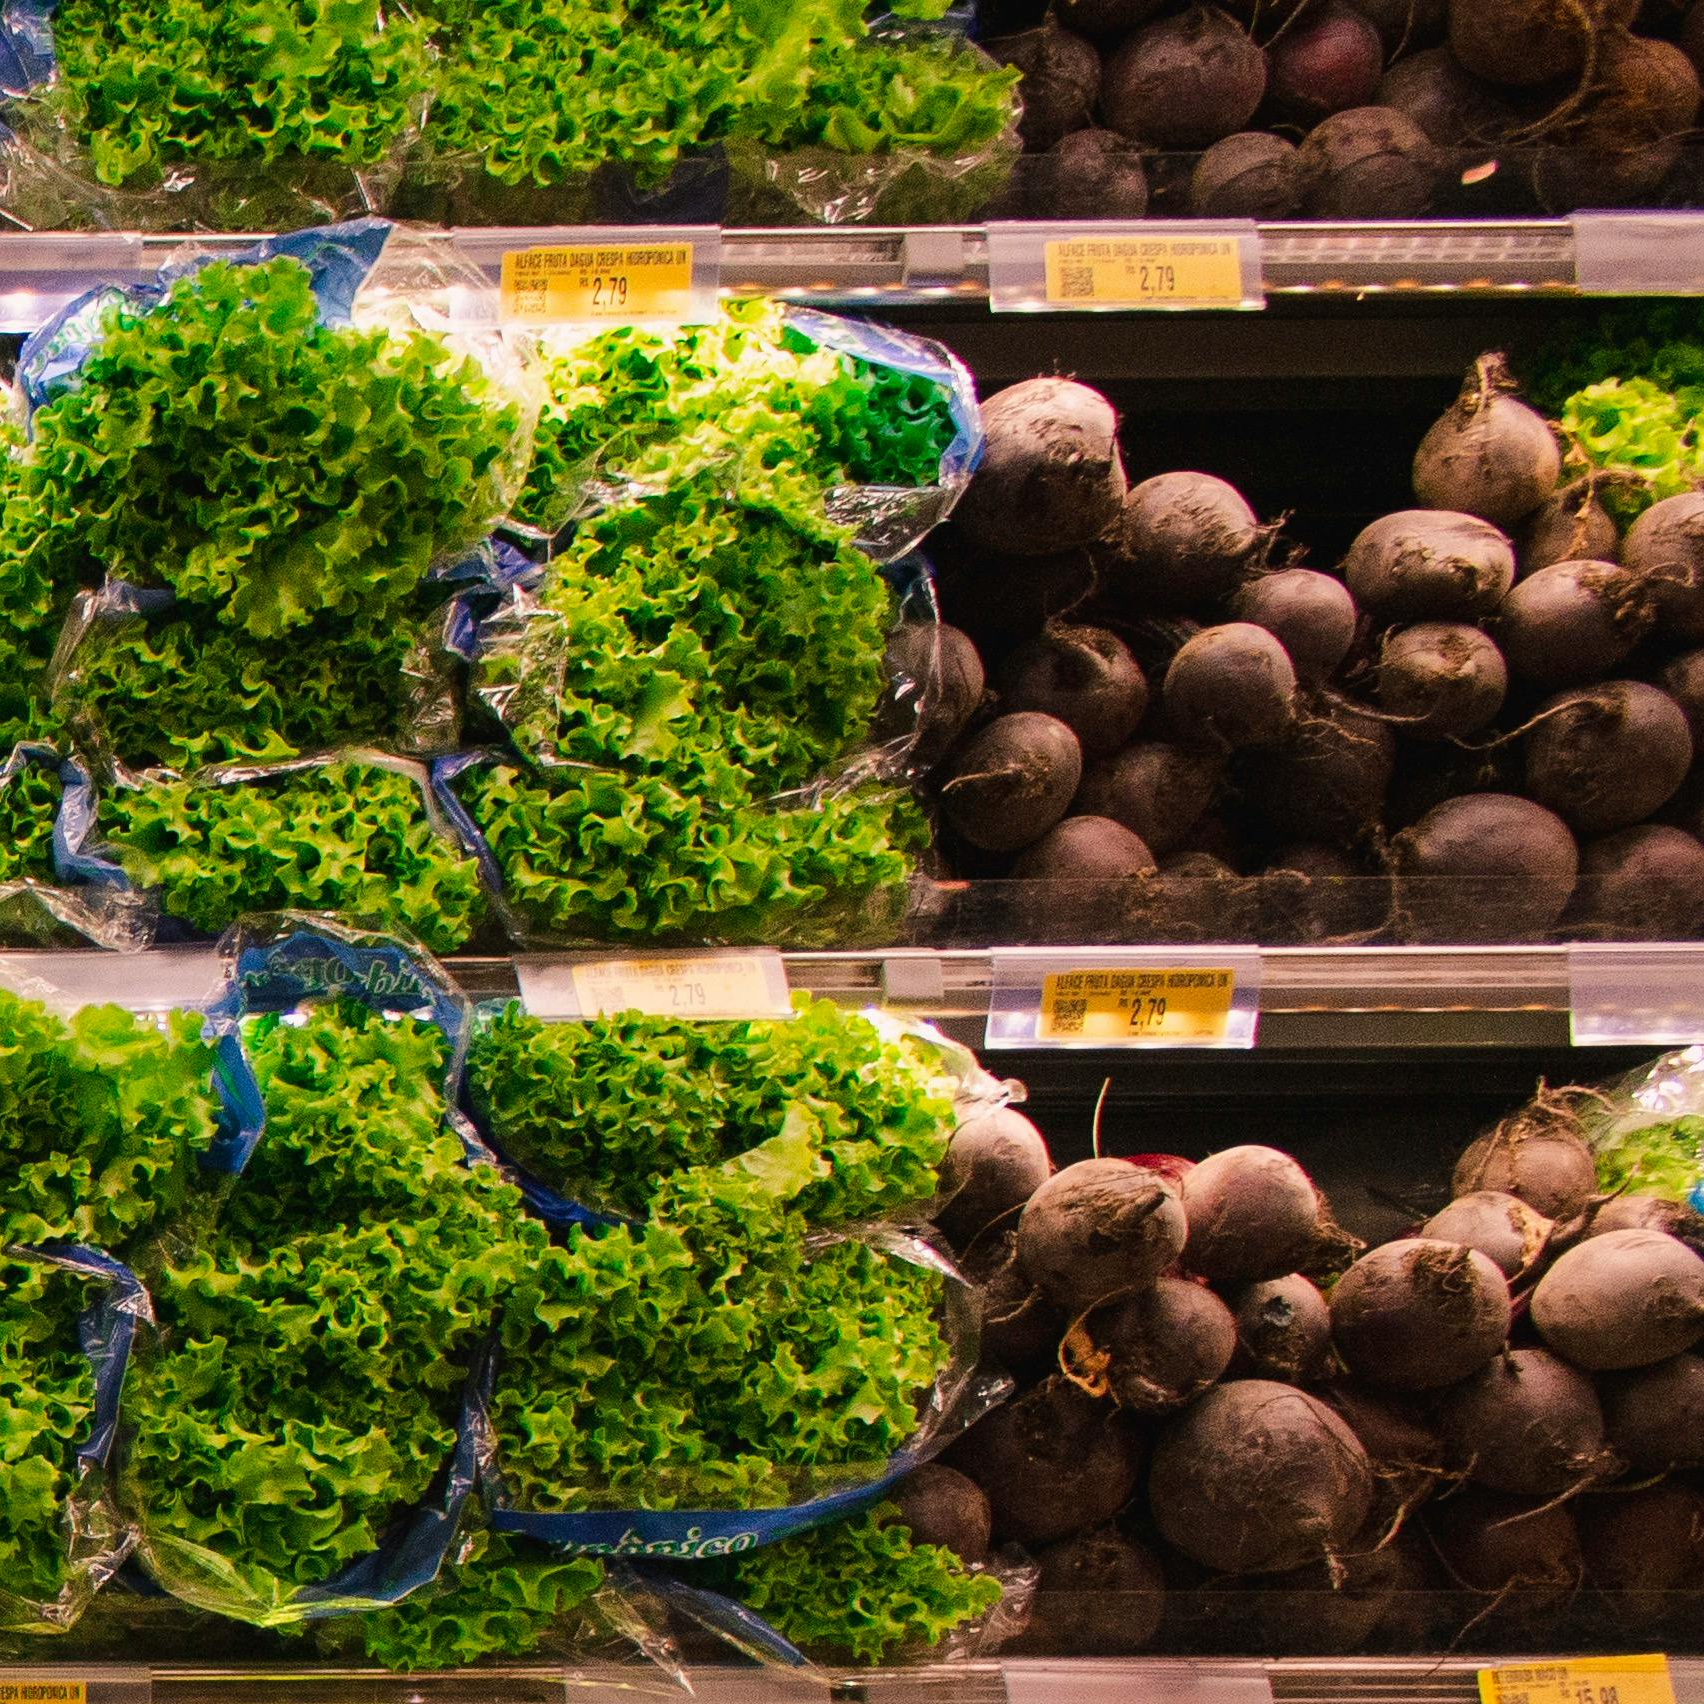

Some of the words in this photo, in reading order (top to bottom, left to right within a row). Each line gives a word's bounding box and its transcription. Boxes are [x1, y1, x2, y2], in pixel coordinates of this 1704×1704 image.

[592, 276, 628, 309] 2,79
[1140, 265, 1175, 294] 2,79
[668, 982, 706, 1007] 2,79
[1129, 997, 1167, 1028] 2,79
